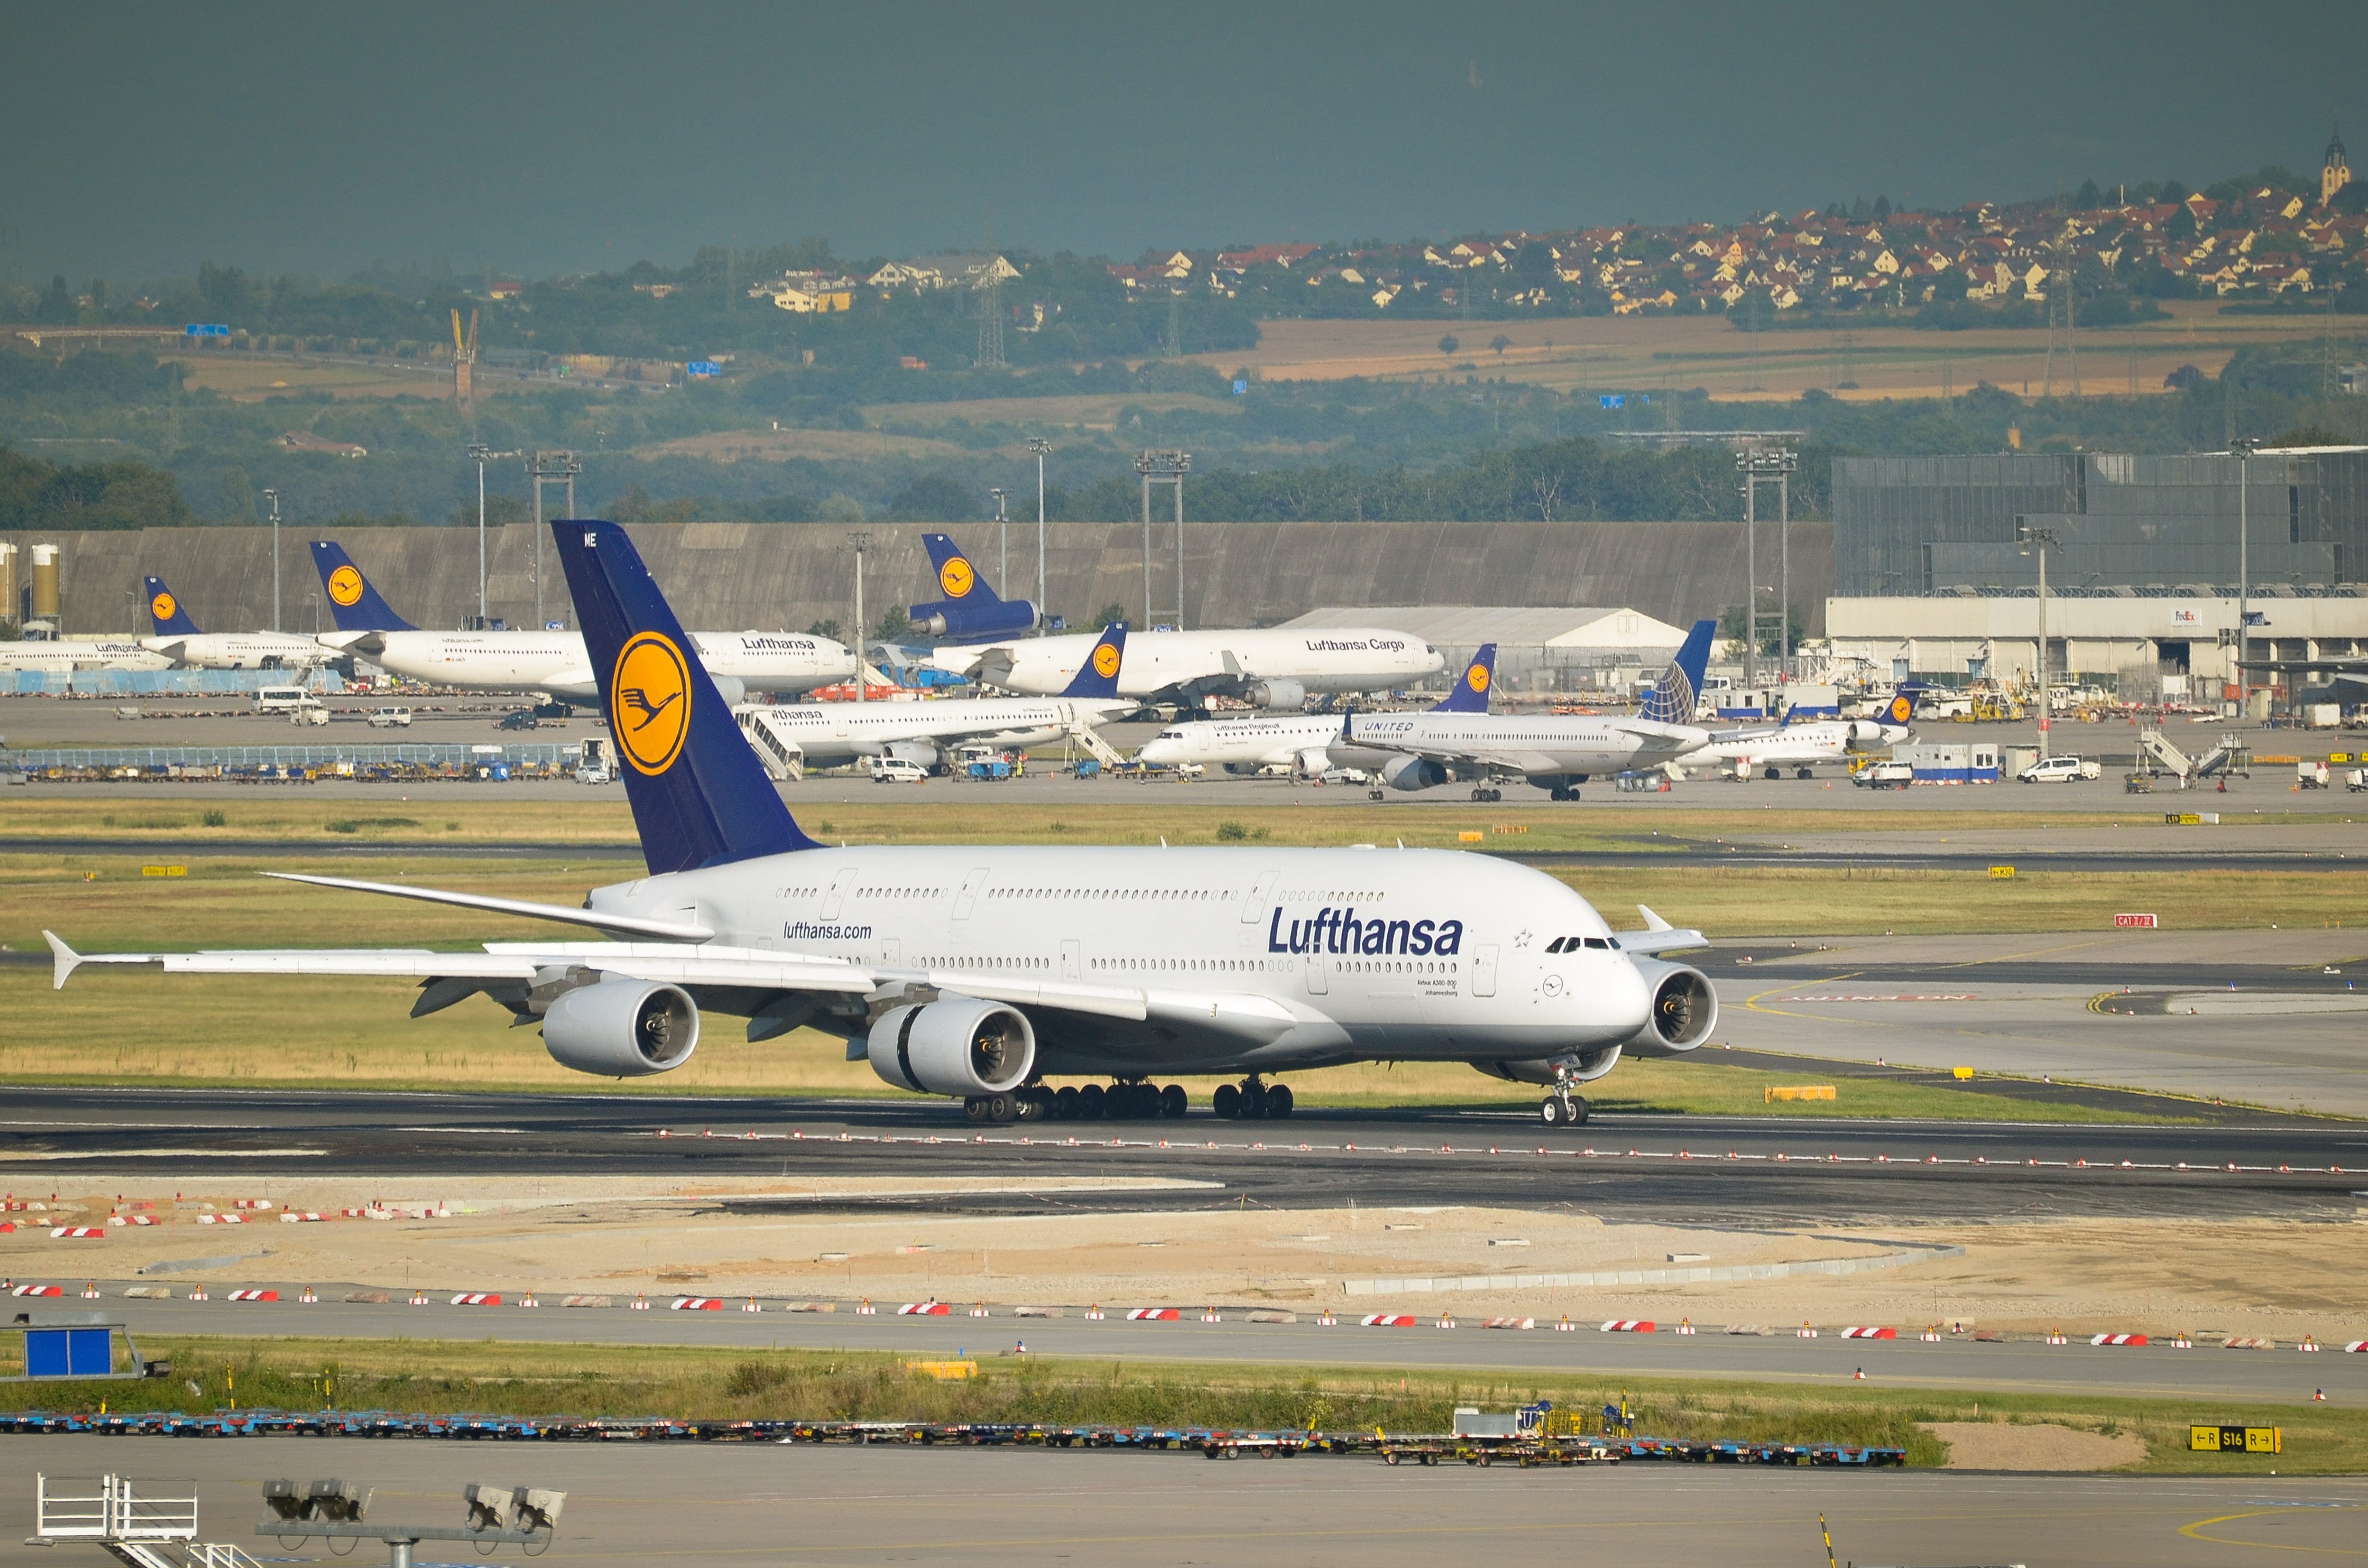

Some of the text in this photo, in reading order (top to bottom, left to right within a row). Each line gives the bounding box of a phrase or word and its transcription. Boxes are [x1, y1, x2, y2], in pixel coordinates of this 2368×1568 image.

[584, 533, 597, 547] ME
[2176, 610, 2195, 621] FedEx
[741, 637, 816, 649] Lufthansa
[1306, 639, 1405, 653] Lufthansa Cargo
[1365, 723, 1414, 731] UNITED
[2118, 917, 2132, 926] CAT
[783, 921, 872, 939] lufthansa.com
[1268, 906, 1463, 956] Lufthansa
[2209, 1432, 2257, 1446] R S16 R
